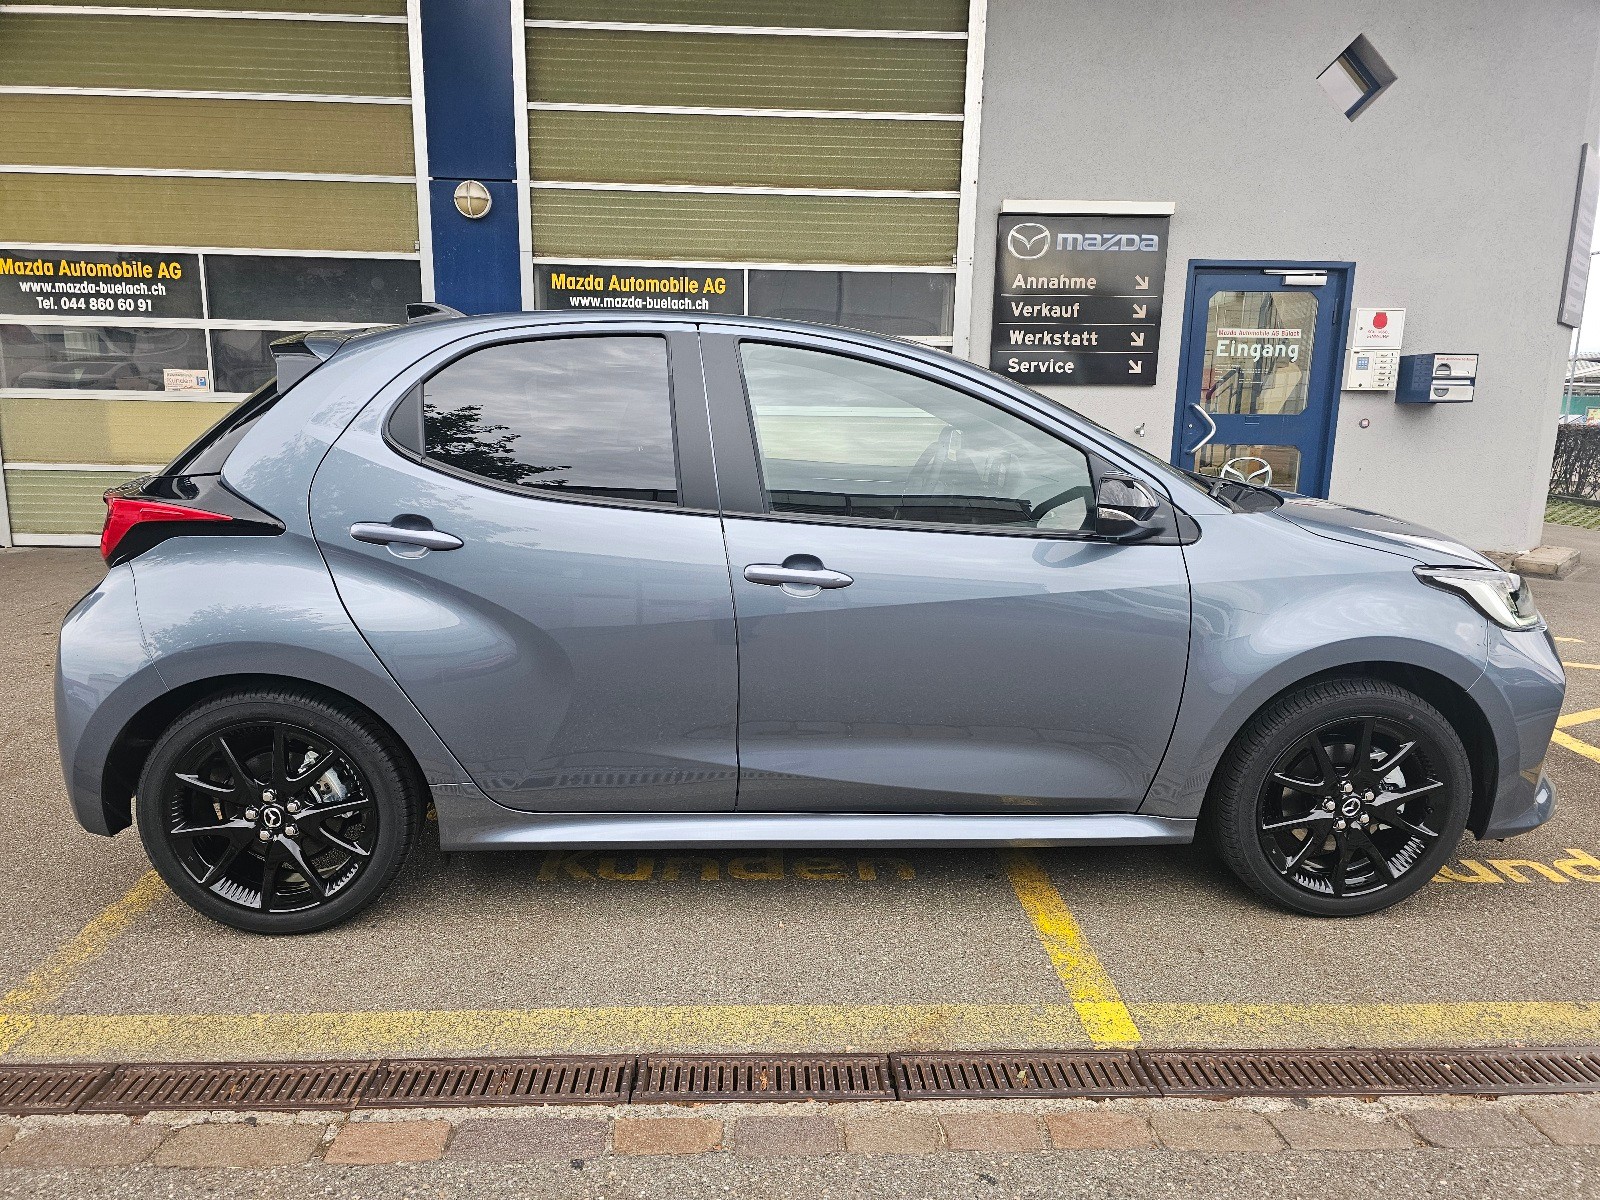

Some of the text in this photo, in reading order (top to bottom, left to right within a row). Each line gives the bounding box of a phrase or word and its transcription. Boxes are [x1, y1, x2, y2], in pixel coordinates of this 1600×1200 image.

[0, 258, 182, 280] Mazda Automobile AG
[19, 281, 166, 296] www.mazda-buelach.ch
[551, 273, 727, 294] Mazda Automobile AG
[1011, 273, 1097, 290] Annahme
[36, 296, 153, 312] Tel. 044 860 60 91
[569, 295, 709, 310] www.mazda-buelach.ch
[1011, 301, 1080, 317] Verkauf
[1009, 329, 1099, 346] Werkstatt
[1216, 339, 1300, 363] Eingang
[1008, 357, 1075, 374] Service
[537, 848, 917, 881] Kunden
[1431, 848, 1600, 883] und
